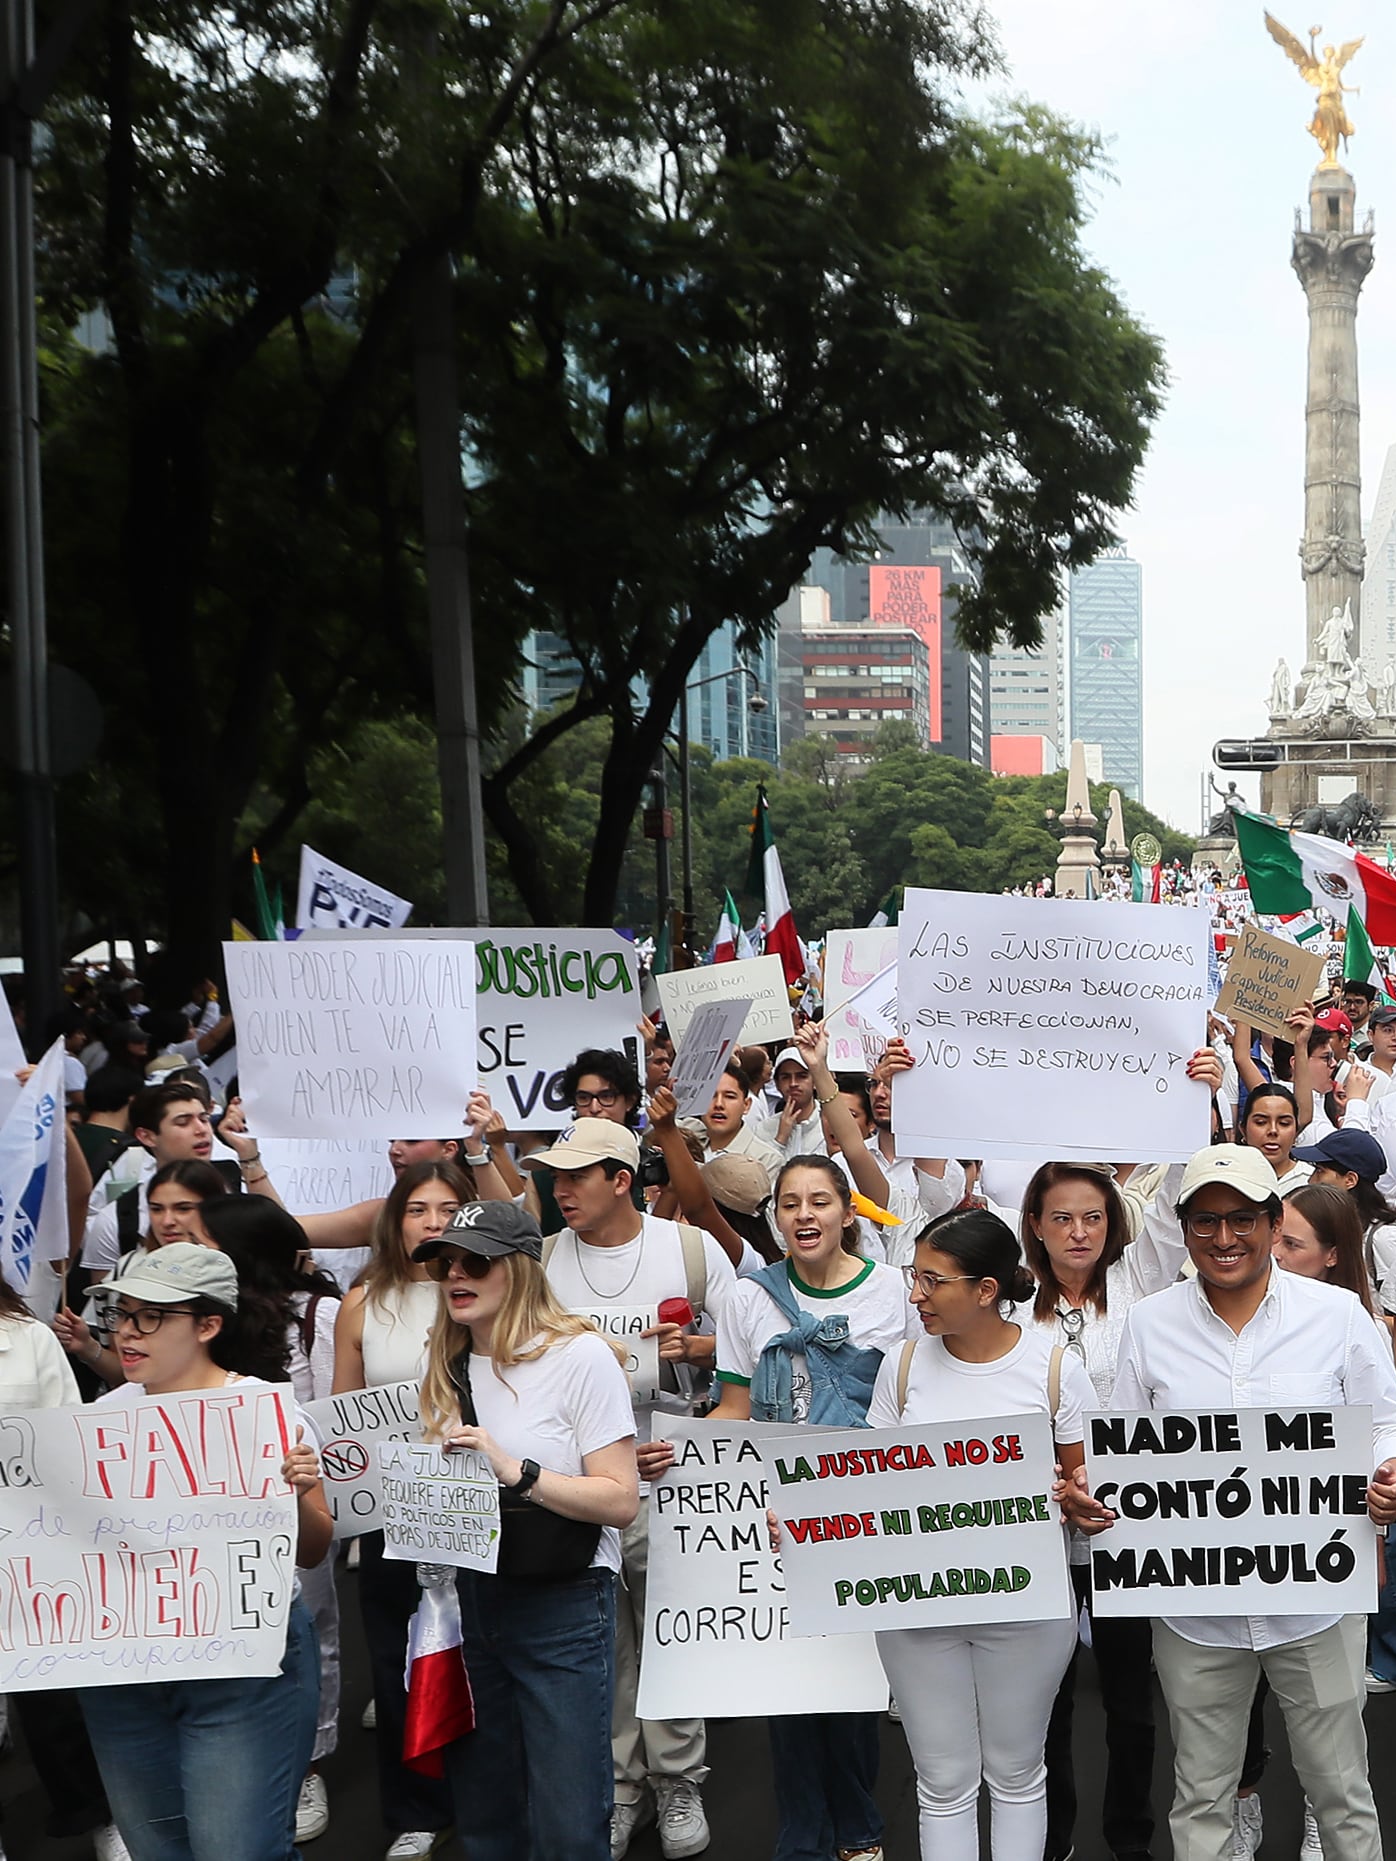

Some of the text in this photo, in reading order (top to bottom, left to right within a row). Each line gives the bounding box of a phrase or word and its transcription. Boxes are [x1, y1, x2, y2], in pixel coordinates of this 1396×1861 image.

[903, 570, 925, 580] KM
[882, 602, 928, 613] PODER
[887, 591, 923, 602] PARA
[874, 613, 937, 624] POSTEAR
[909, 921, 1196, 966] LAS INSTITUCIONES
[1244, 932, 1289, 970] Reforma
[238, 950, 470, 1010] SIN PODER JUDICIAL
[933, 972, 1205, 1001] DE NUESTRA DEMOCRACIA
[916, 1008, 956, 1028] SE
[961, 1010, 1141, 1036] PERFECCIONAN,
[1234, 989, 1290, 1023] Presidencial
[247, 1009, 441, 1057] QUIEN TE VA A
[477, 1023, 527, 1073] SE
[973, 1047, 1009, 1069] SE
[291, 1065, 426, 1120] AMPARAR
[72, 1392, 294, 1499] FALTA
[1091, 1412, 1336, 1455] NADIE ME
[322, 1445, 367, 1477] NO
[379, 1446, 494, 1480] LA JUSTICIA
[775, 1434, 1024, 1485] LA JUSTICIA NO SE
[382, 1476, 498, 1513] REQUIERE EXPERTOS
[1093, 1466, 1369, 1520] CONTÓ NI ME
[16, 1505, 295, 1544] de preparación
[383, 1504, 484, 1531] NO POLÍTICOS EN
[386, 1522, 424, 1549] ROPAS
[428, 1530, 444, 1549] DE
[784, 1494, 1051, 1545] VENDE NI REQUIERE
[1092, 1529, 1356, 1591] MANIPULÓ
[227, 1534, 291, 1632] ES
[835, 1565, 1031, 1606] POPULARIDAD
[2, 1636, 256, 1684] corrupción
